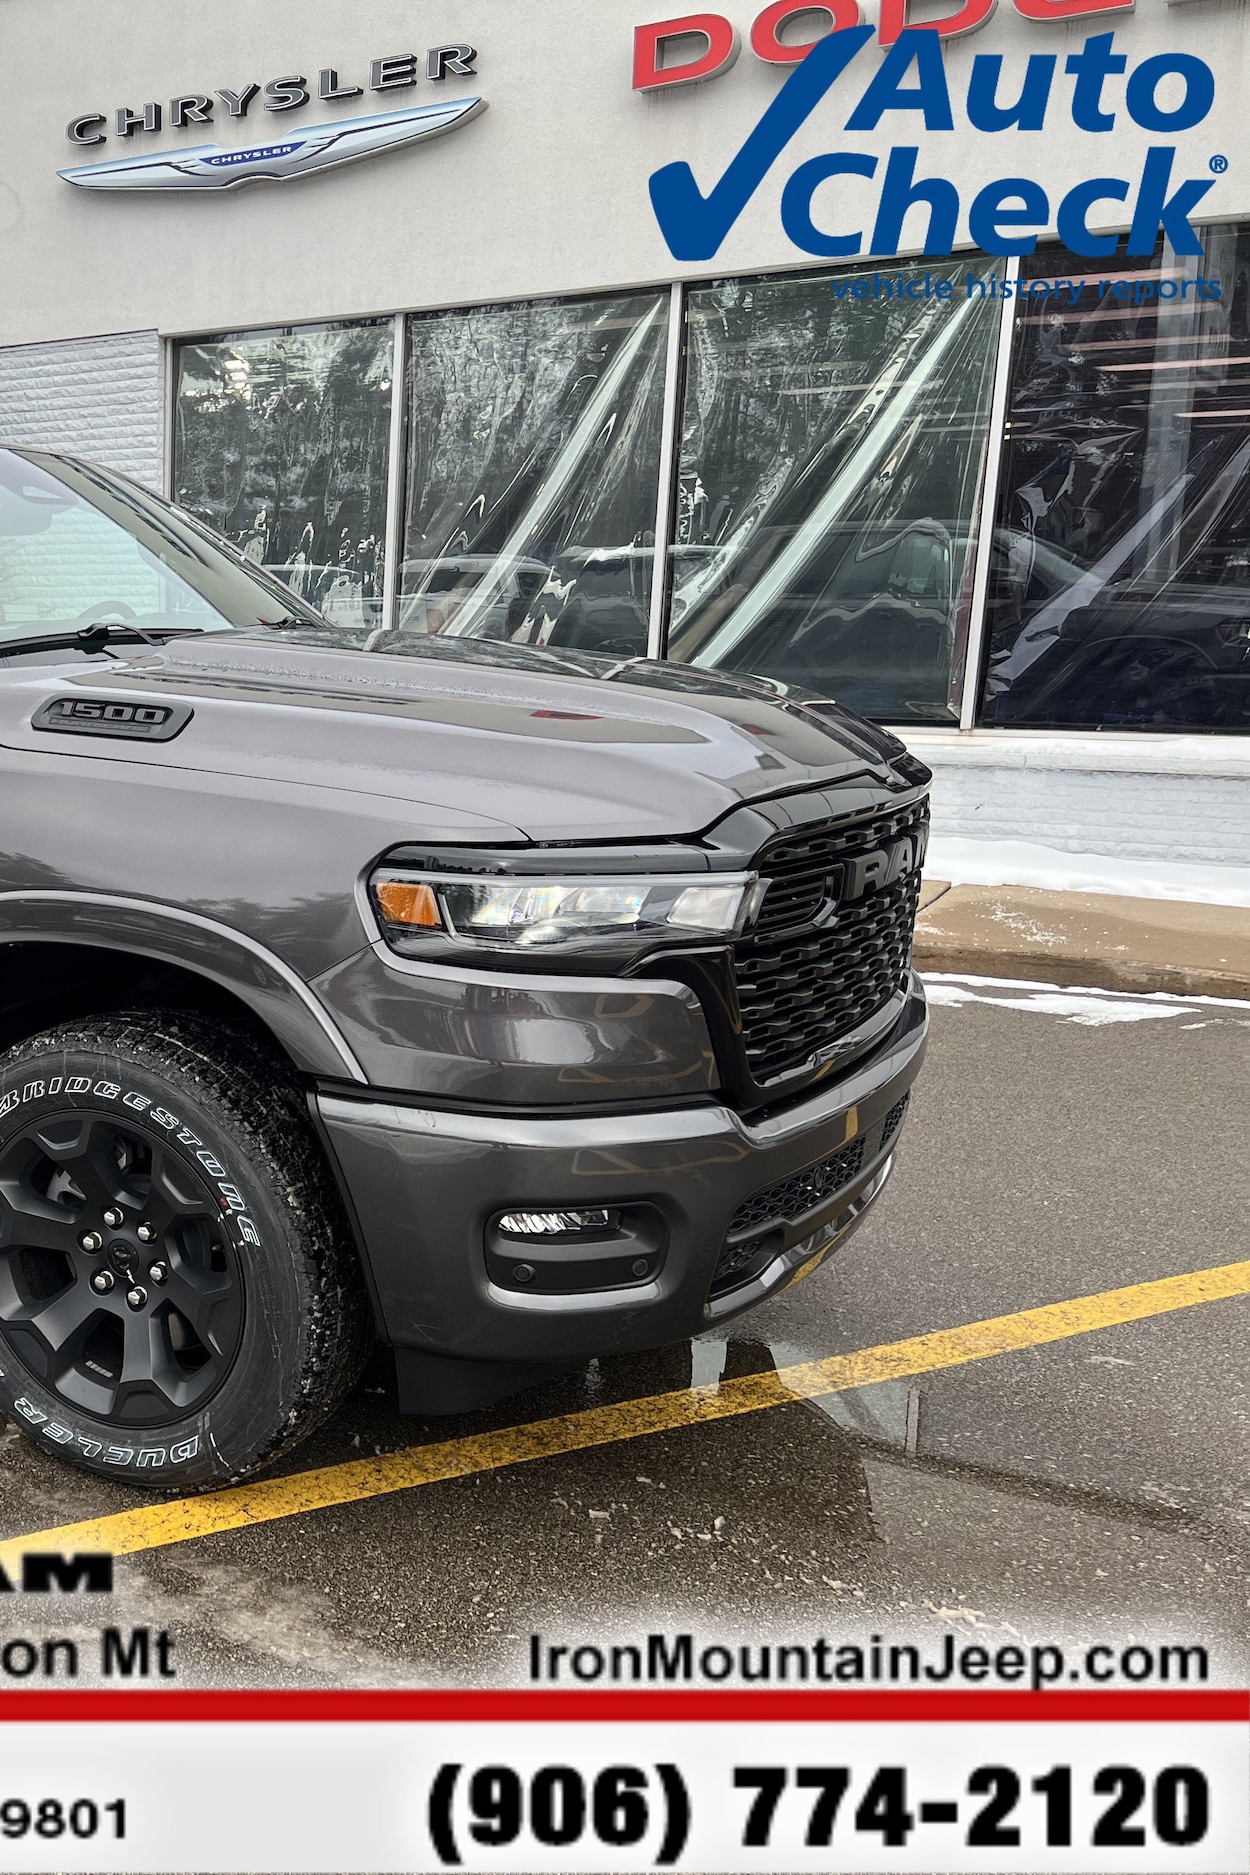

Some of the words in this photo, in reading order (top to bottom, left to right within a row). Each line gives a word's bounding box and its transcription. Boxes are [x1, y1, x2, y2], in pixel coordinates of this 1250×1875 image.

[64, 43, 478, 146] CHRYSLER
[211, 146, 293, 165] CHRYSLER
[59, 701, 168, 725] 1500
[13, 1396, 200, 1469] DUELER
